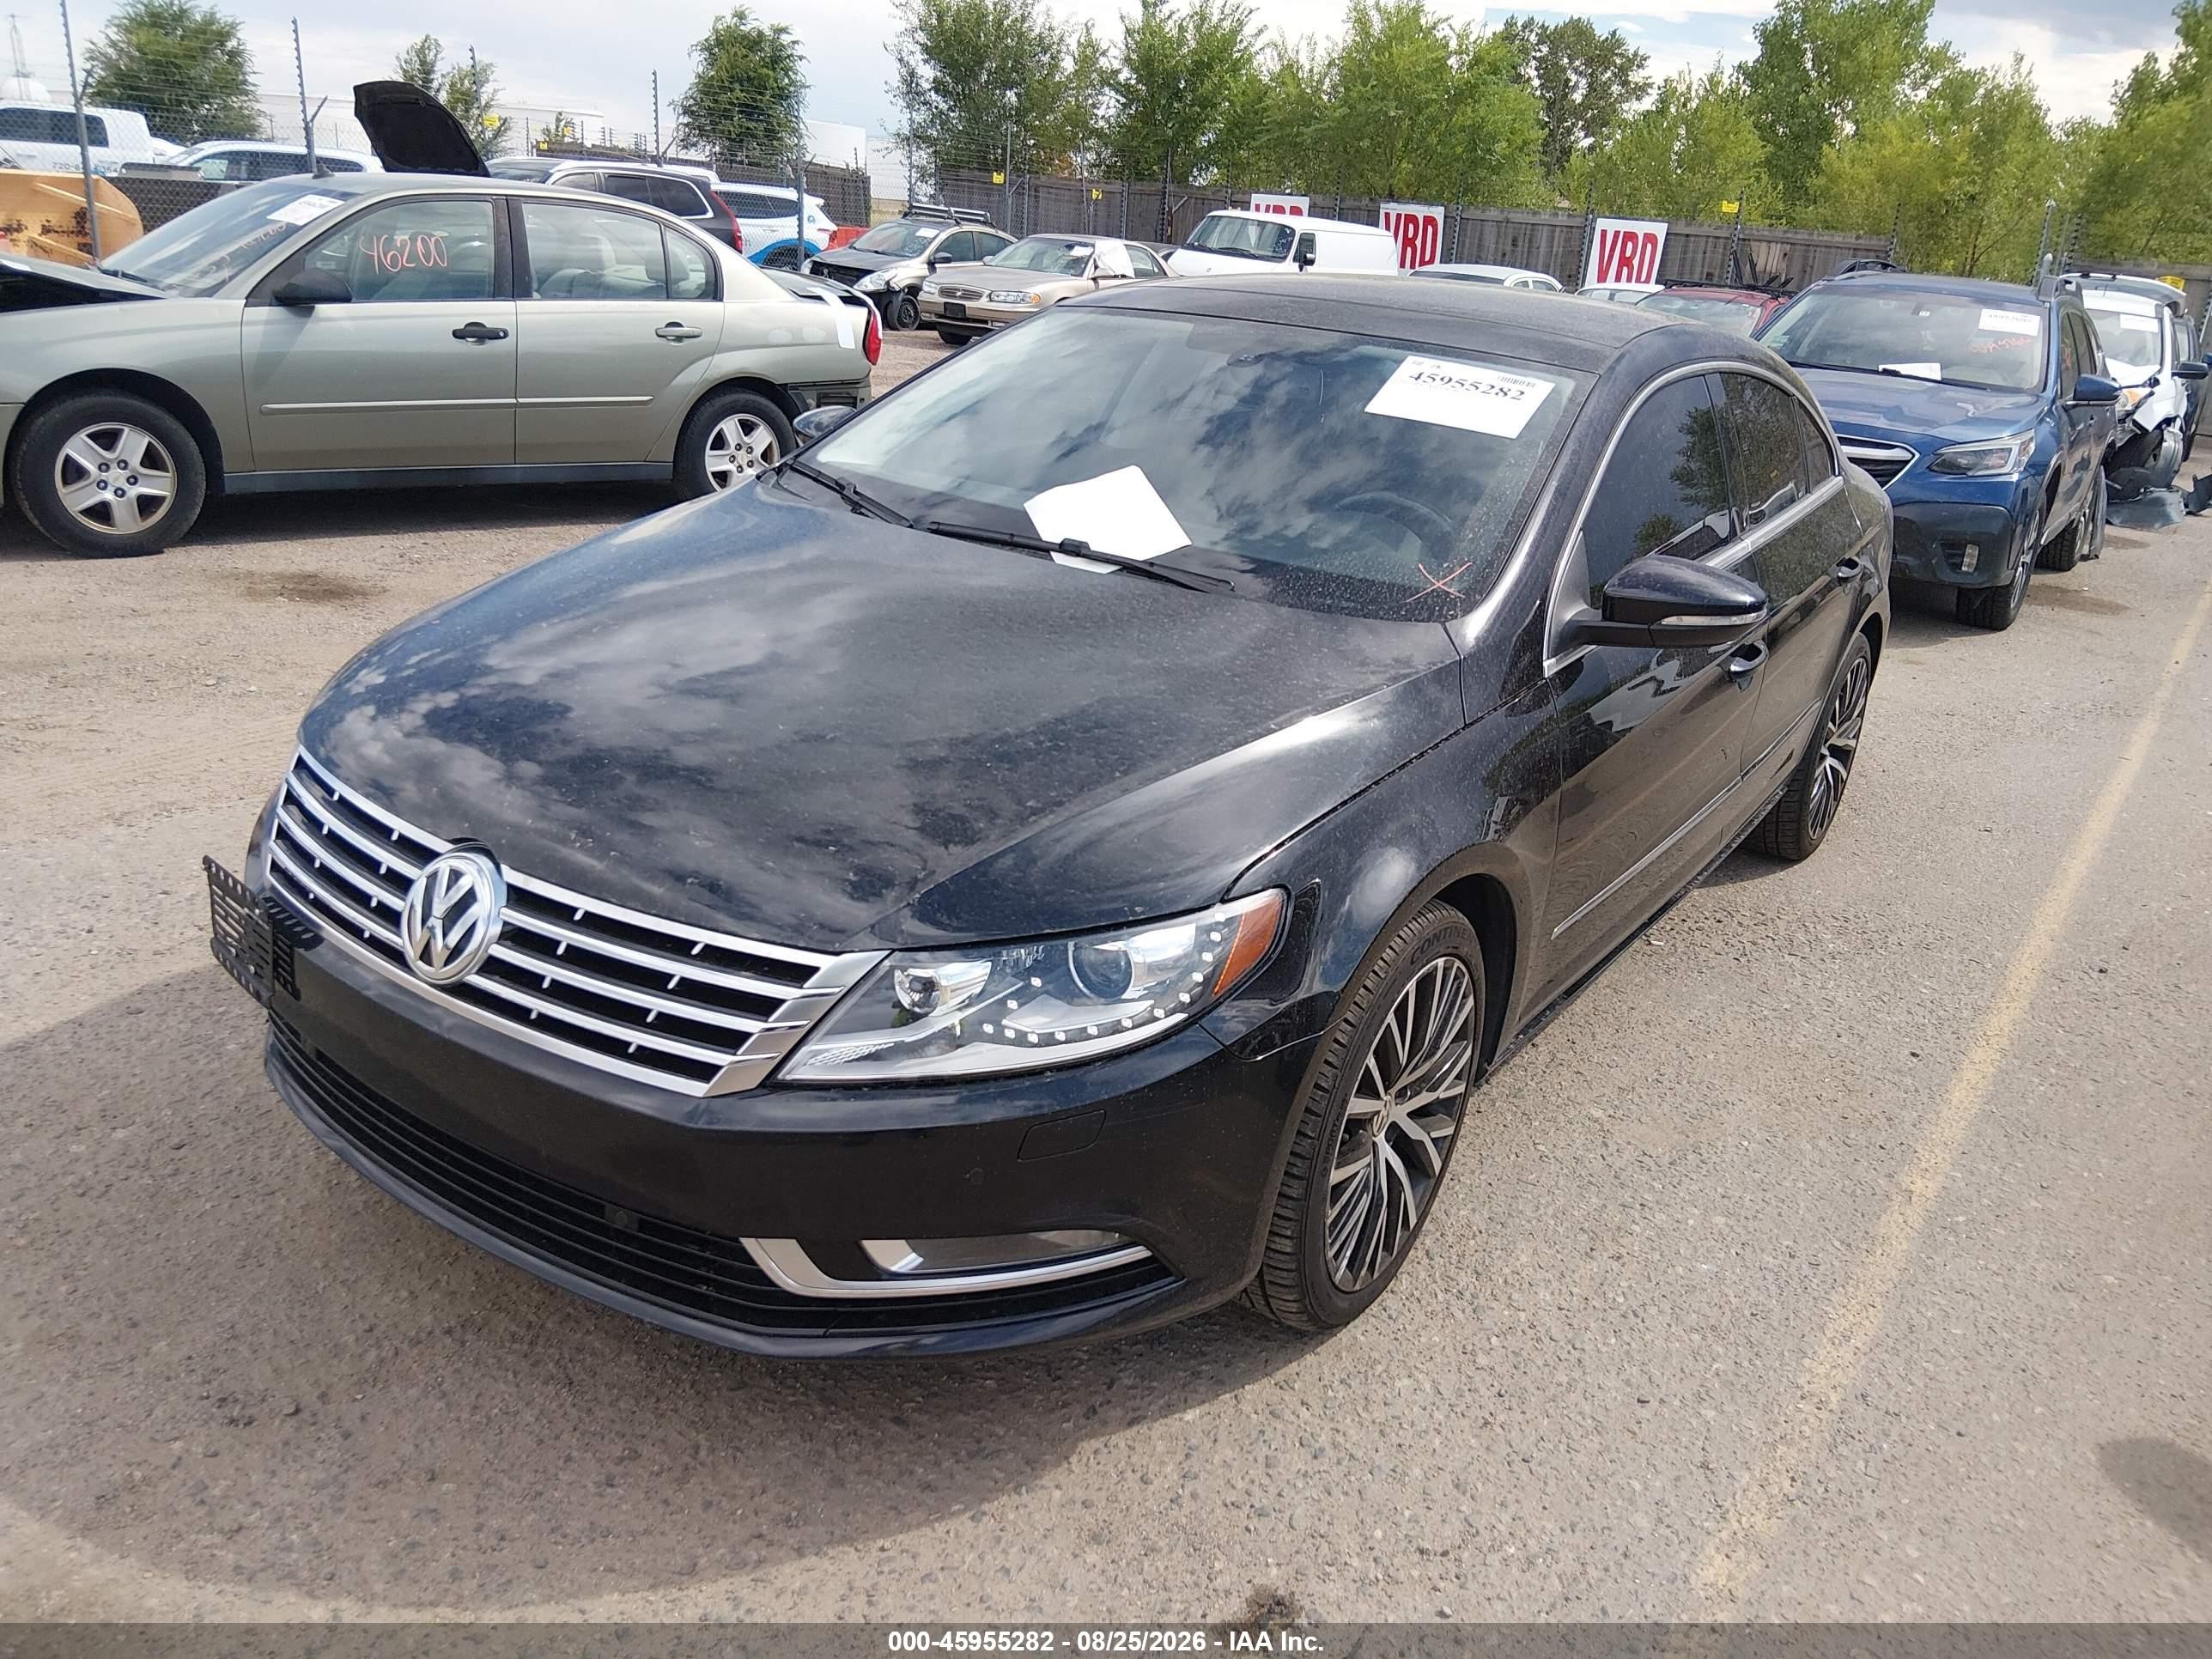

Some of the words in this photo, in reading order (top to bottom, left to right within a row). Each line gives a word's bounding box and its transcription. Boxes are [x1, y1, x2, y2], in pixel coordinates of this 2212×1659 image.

[359, 234, 447, 275] 46200
[1597, 229, 1658, 283] VRD
[1409, 372, 1525, 400] 45955282
